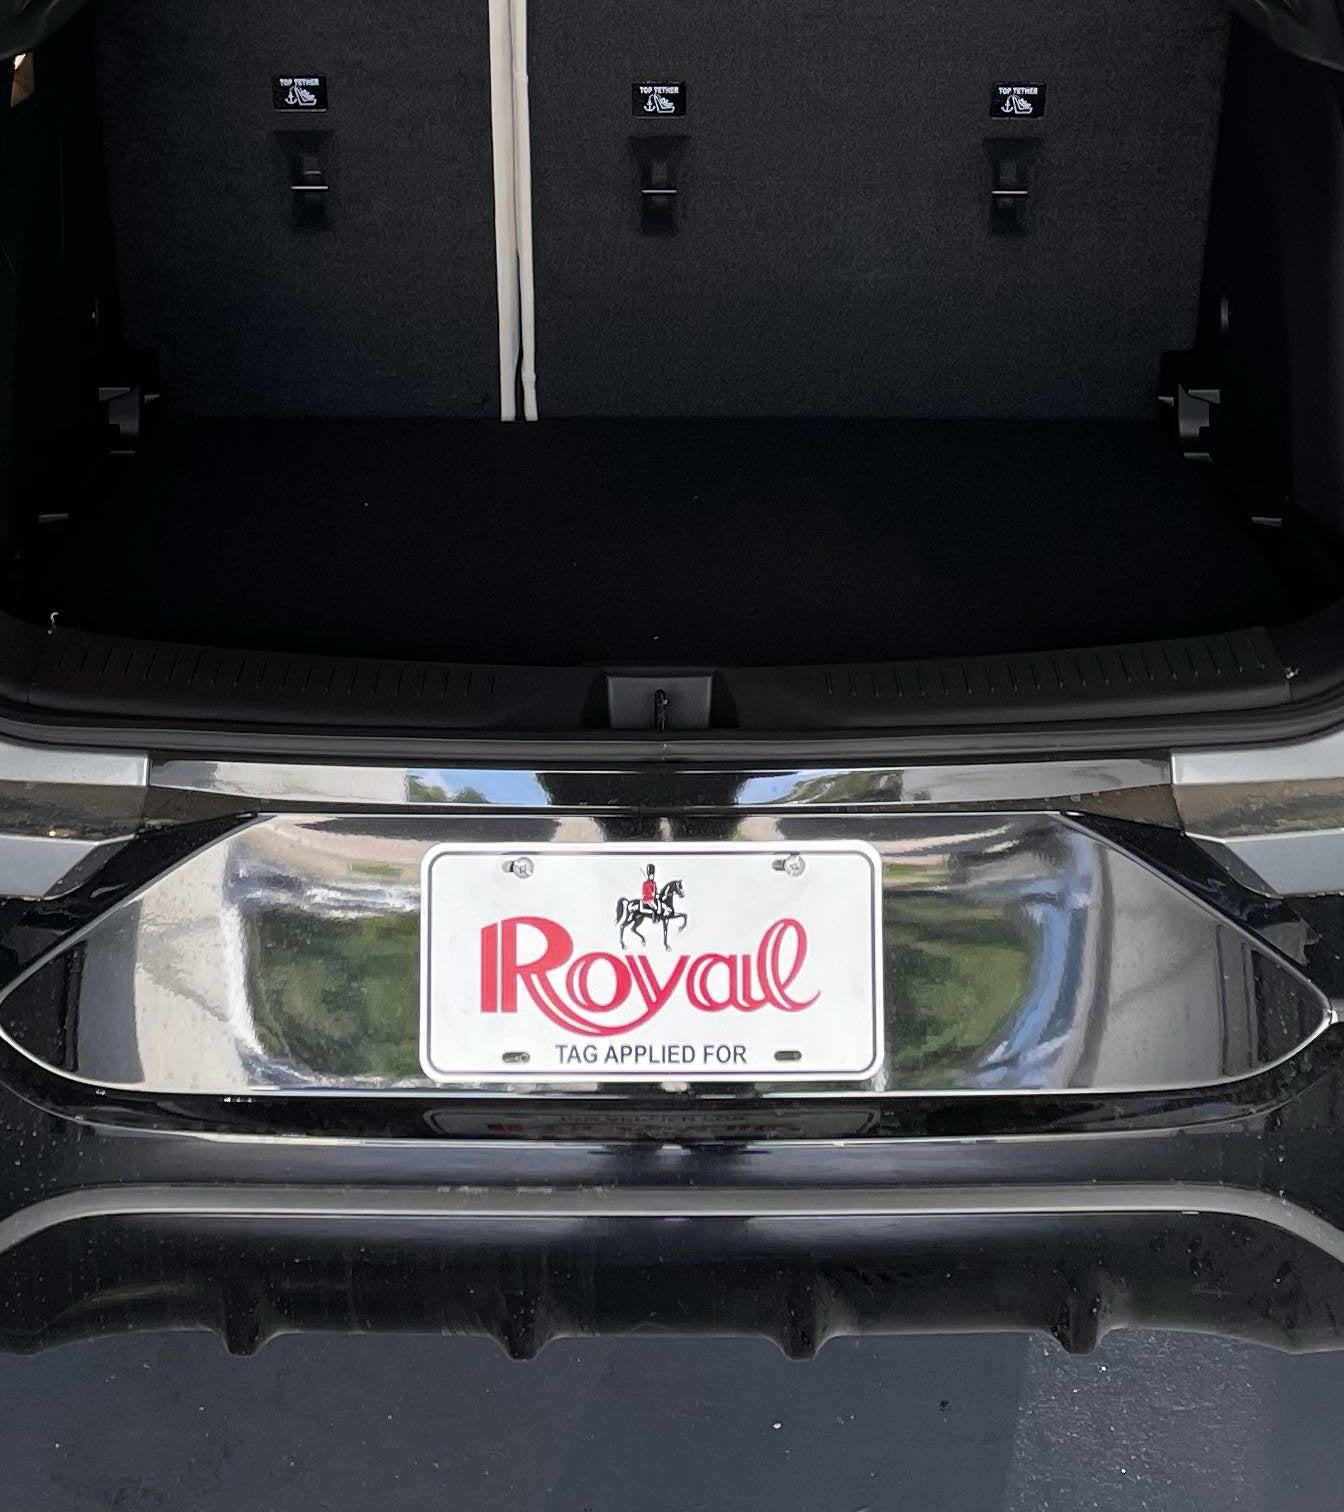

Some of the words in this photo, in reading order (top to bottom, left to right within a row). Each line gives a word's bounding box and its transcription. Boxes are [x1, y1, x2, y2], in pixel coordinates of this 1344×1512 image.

[998, 87, 1012, 95] TOP
[1013, 87, 1038, 95] TETHER
[480, 915, 822, 1037] Royal
[555, 1044, 598, 1064] TAG
[604, 1044, 696, 1064] APPLIED
[703, 1044, 747, 1064] FOR
